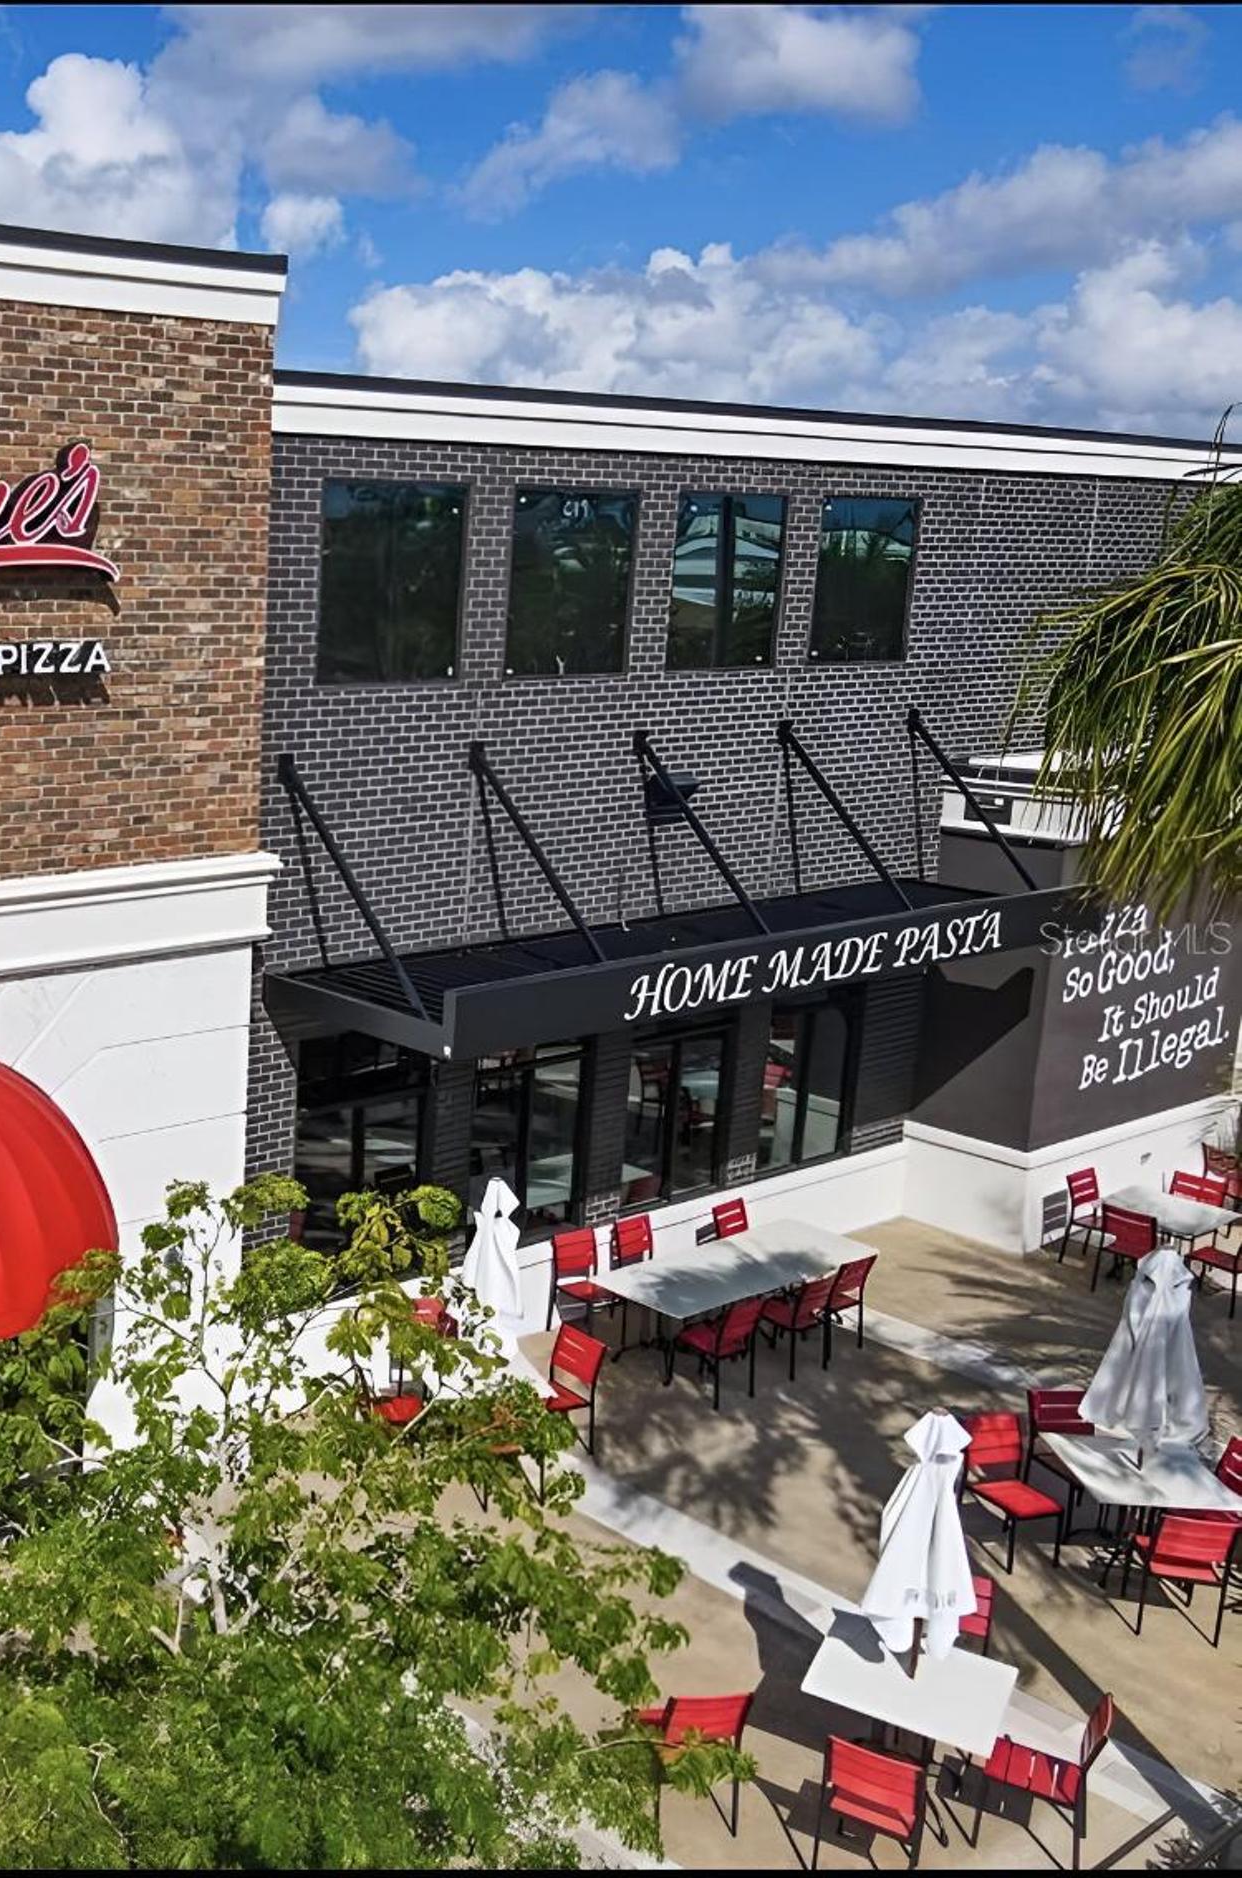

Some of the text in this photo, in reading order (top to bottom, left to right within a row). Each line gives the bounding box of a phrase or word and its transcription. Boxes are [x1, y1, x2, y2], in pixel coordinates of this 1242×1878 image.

[624, 909, 1002, 1021] HOME MADE PASTA
[1063, 967, 1094, 1003] So
[1097, 966, 1220, 1042] It Should
[1078, 1006, 1230, 1090] Be Illegal.
